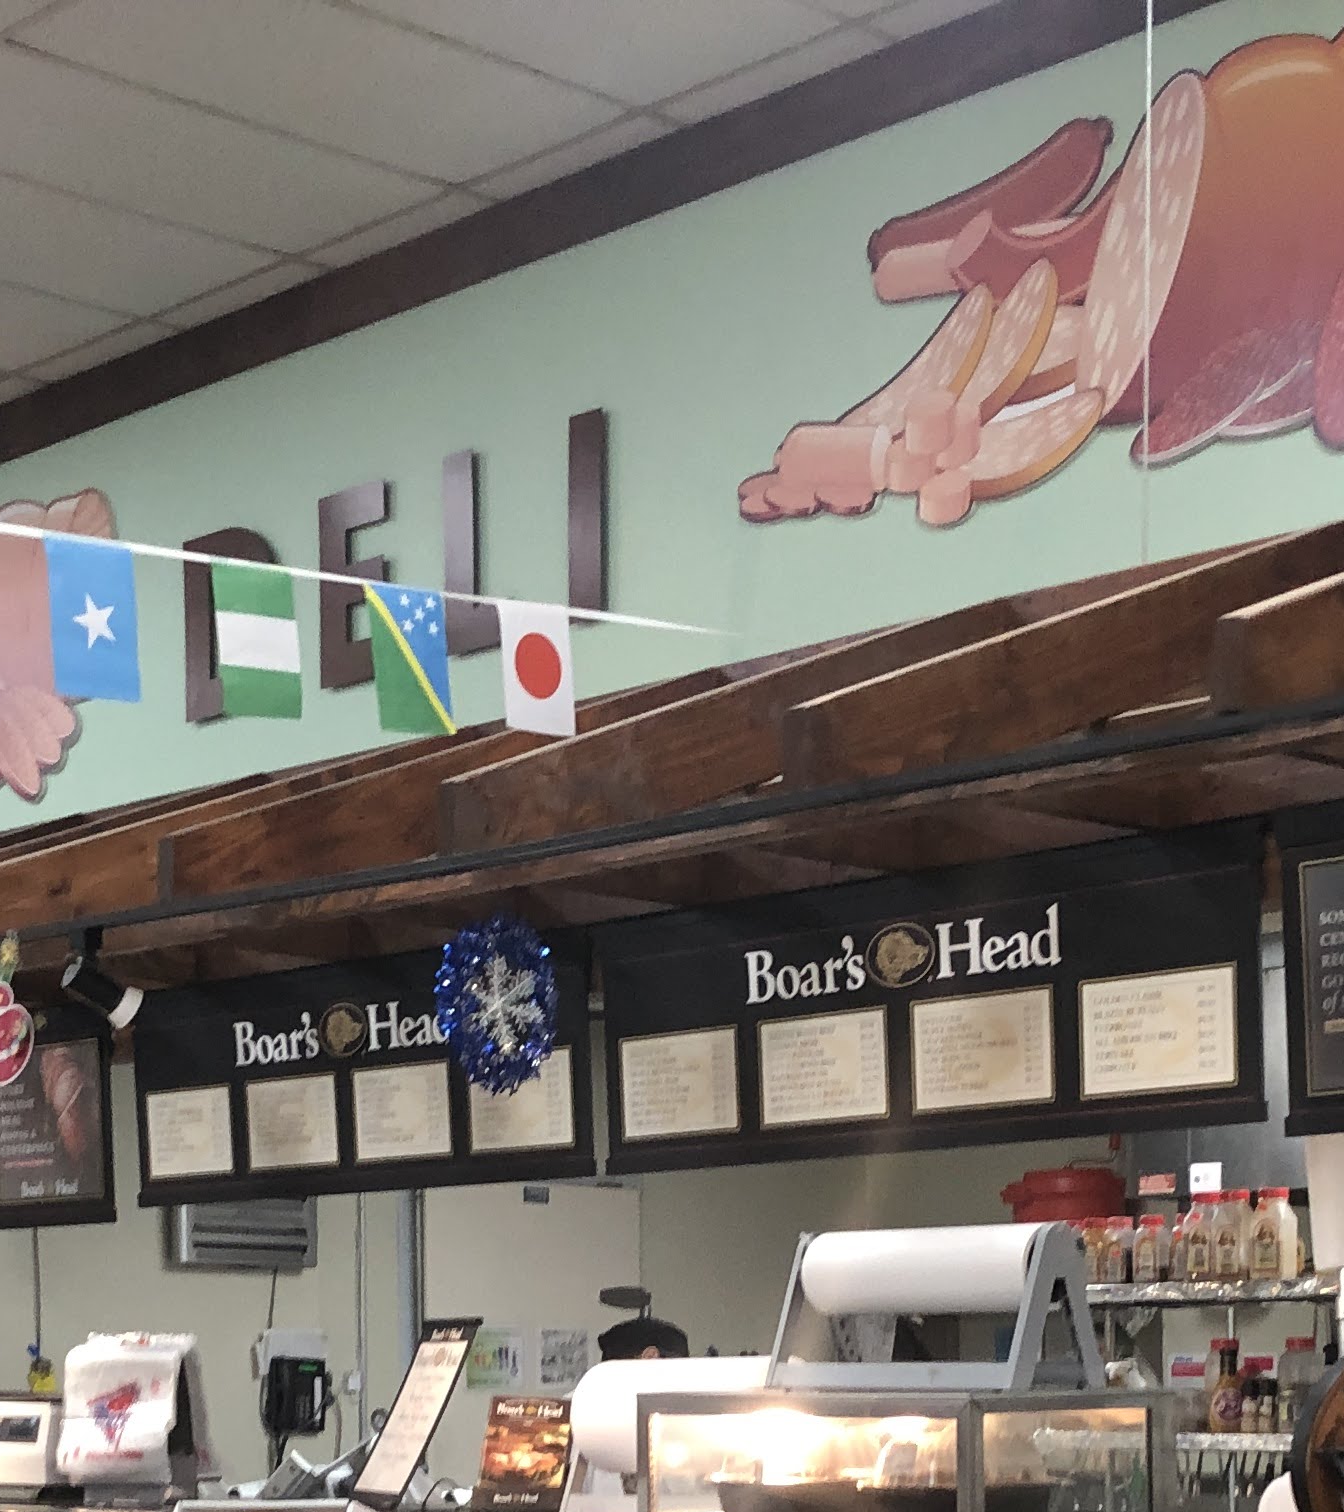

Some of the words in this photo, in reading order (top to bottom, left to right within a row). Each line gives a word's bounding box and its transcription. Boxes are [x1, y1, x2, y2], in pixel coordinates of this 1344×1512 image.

[183, 408, 604, 723] DELI
[744, 934, 866, 1005] Boar's
[934, 902, 1062, 980] Head
[232, 1011, 320, 1068] Boar's
